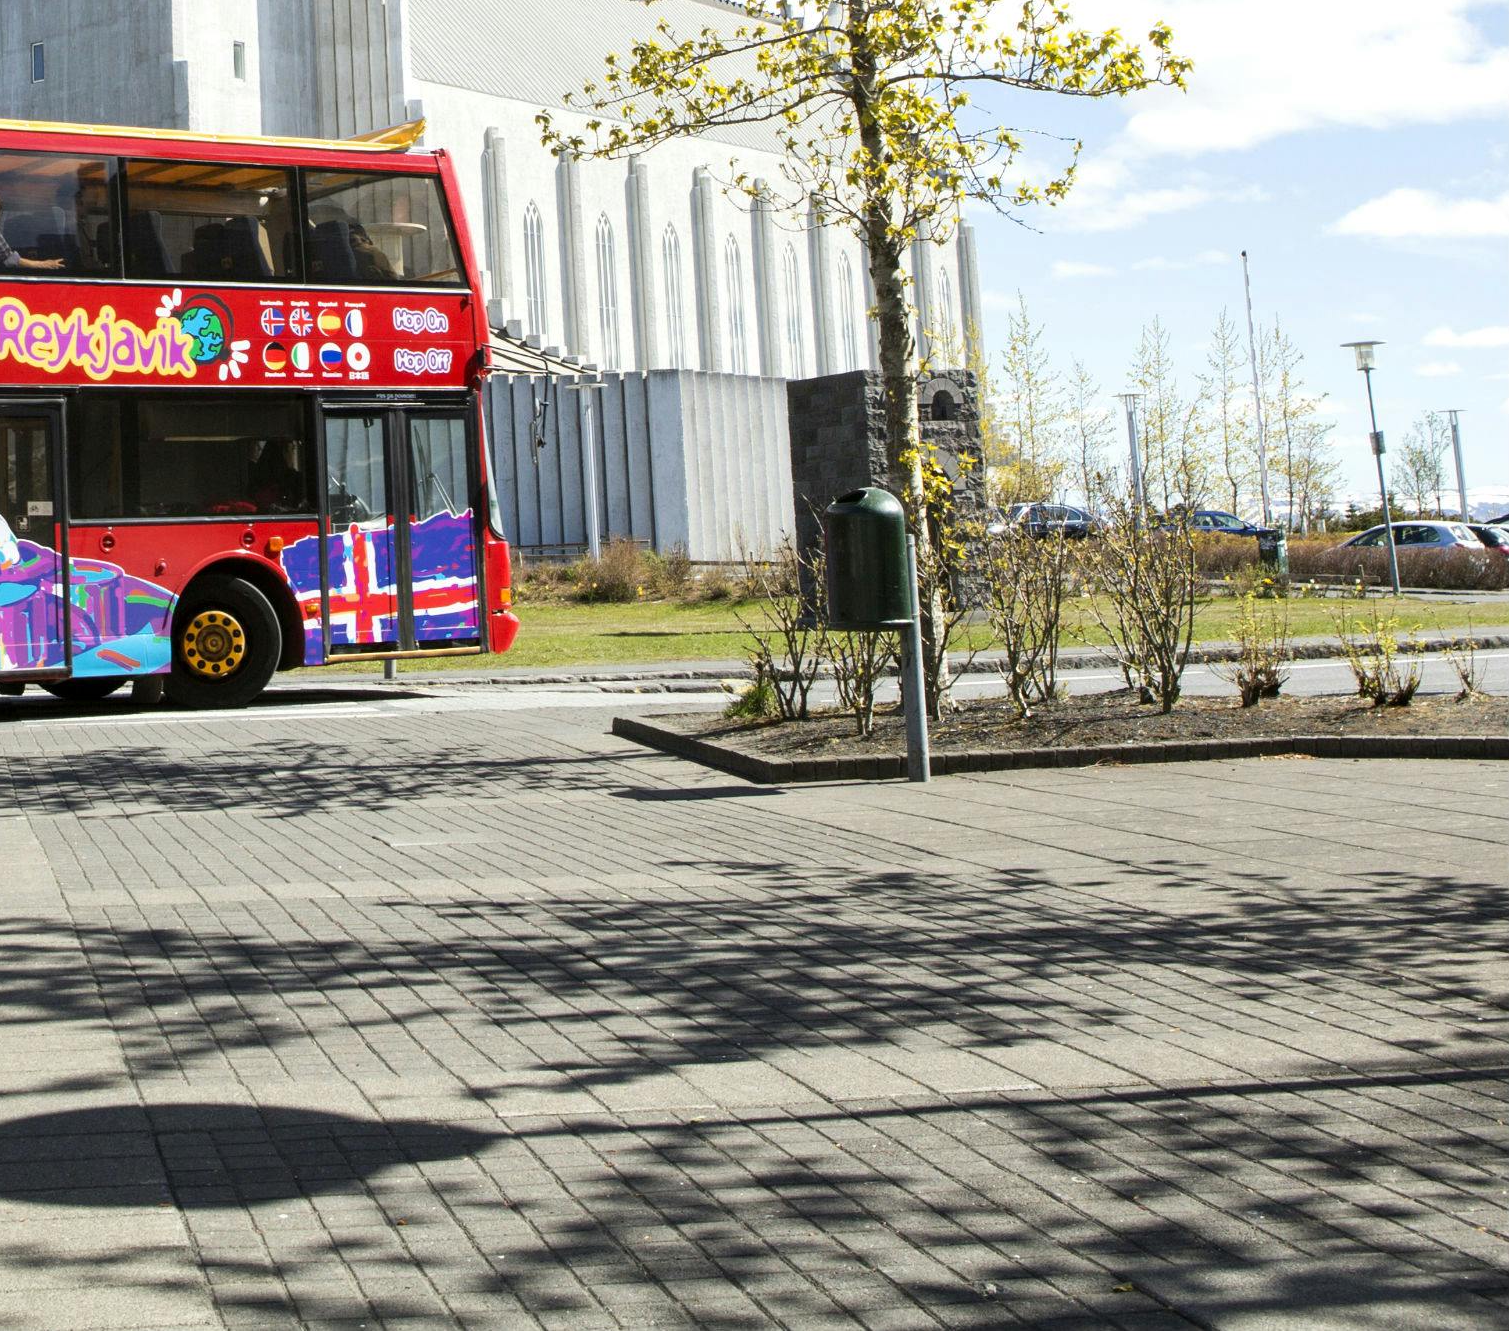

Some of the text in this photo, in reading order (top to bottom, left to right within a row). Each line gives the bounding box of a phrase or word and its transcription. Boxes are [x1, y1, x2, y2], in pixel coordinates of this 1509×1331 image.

[393, 307, 449, 334] Hop On
[394, 348, 453, 375] Hop Off
